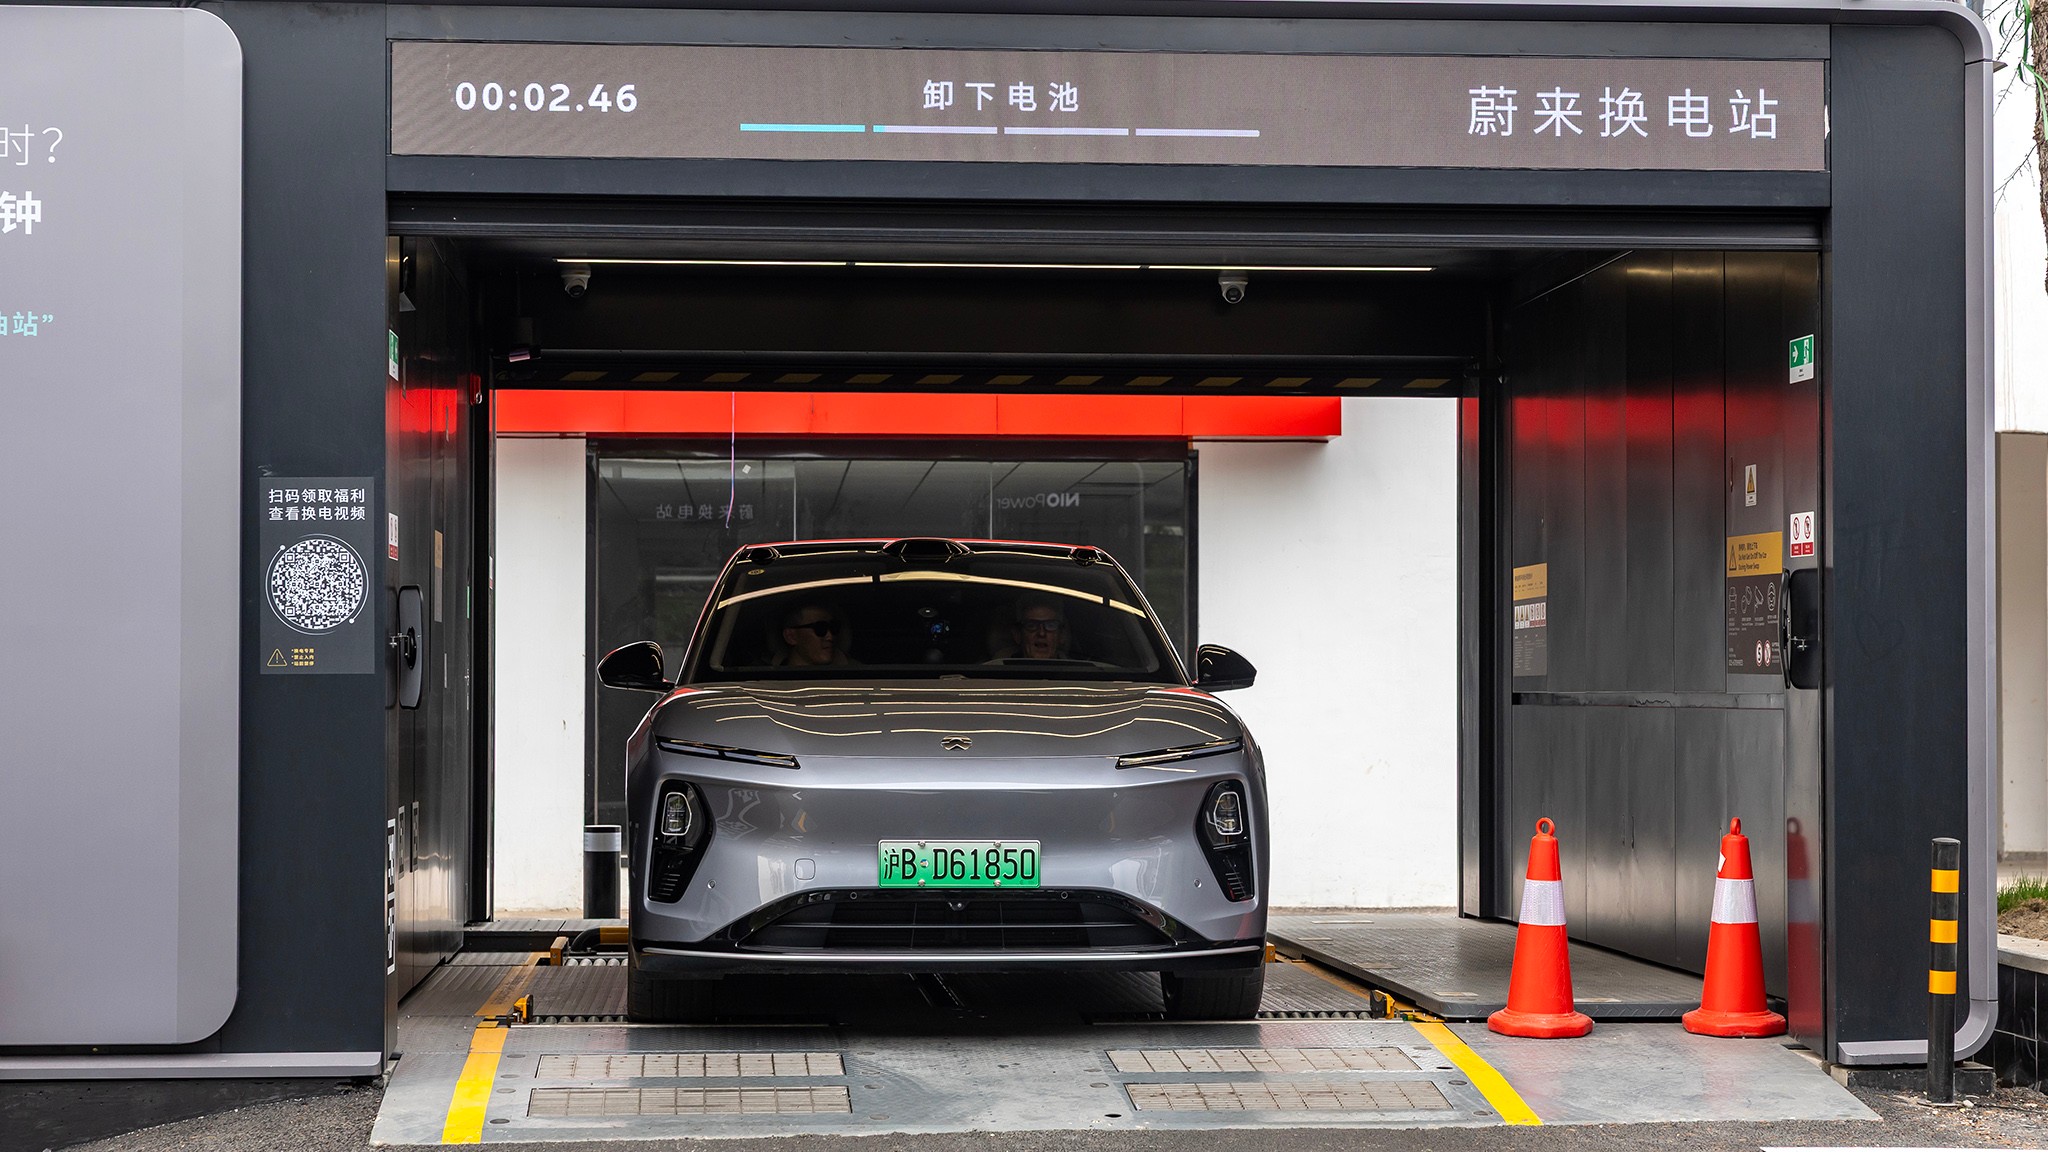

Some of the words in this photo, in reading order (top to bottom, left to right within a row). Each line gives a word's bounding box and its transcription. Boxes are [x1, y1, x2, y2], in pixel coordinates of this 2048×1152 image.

[455, 82, 638, 112] 00:02.46
[923, 79, 1079, 112] 卸下电池
[1467, 85, 1778, 139] 蔚来换电站
[0, 191, 41, 234] 钟
[268, 488, 365, 504] 扫码领取福利
[268, 506, 366, 521] 查看换电视频
